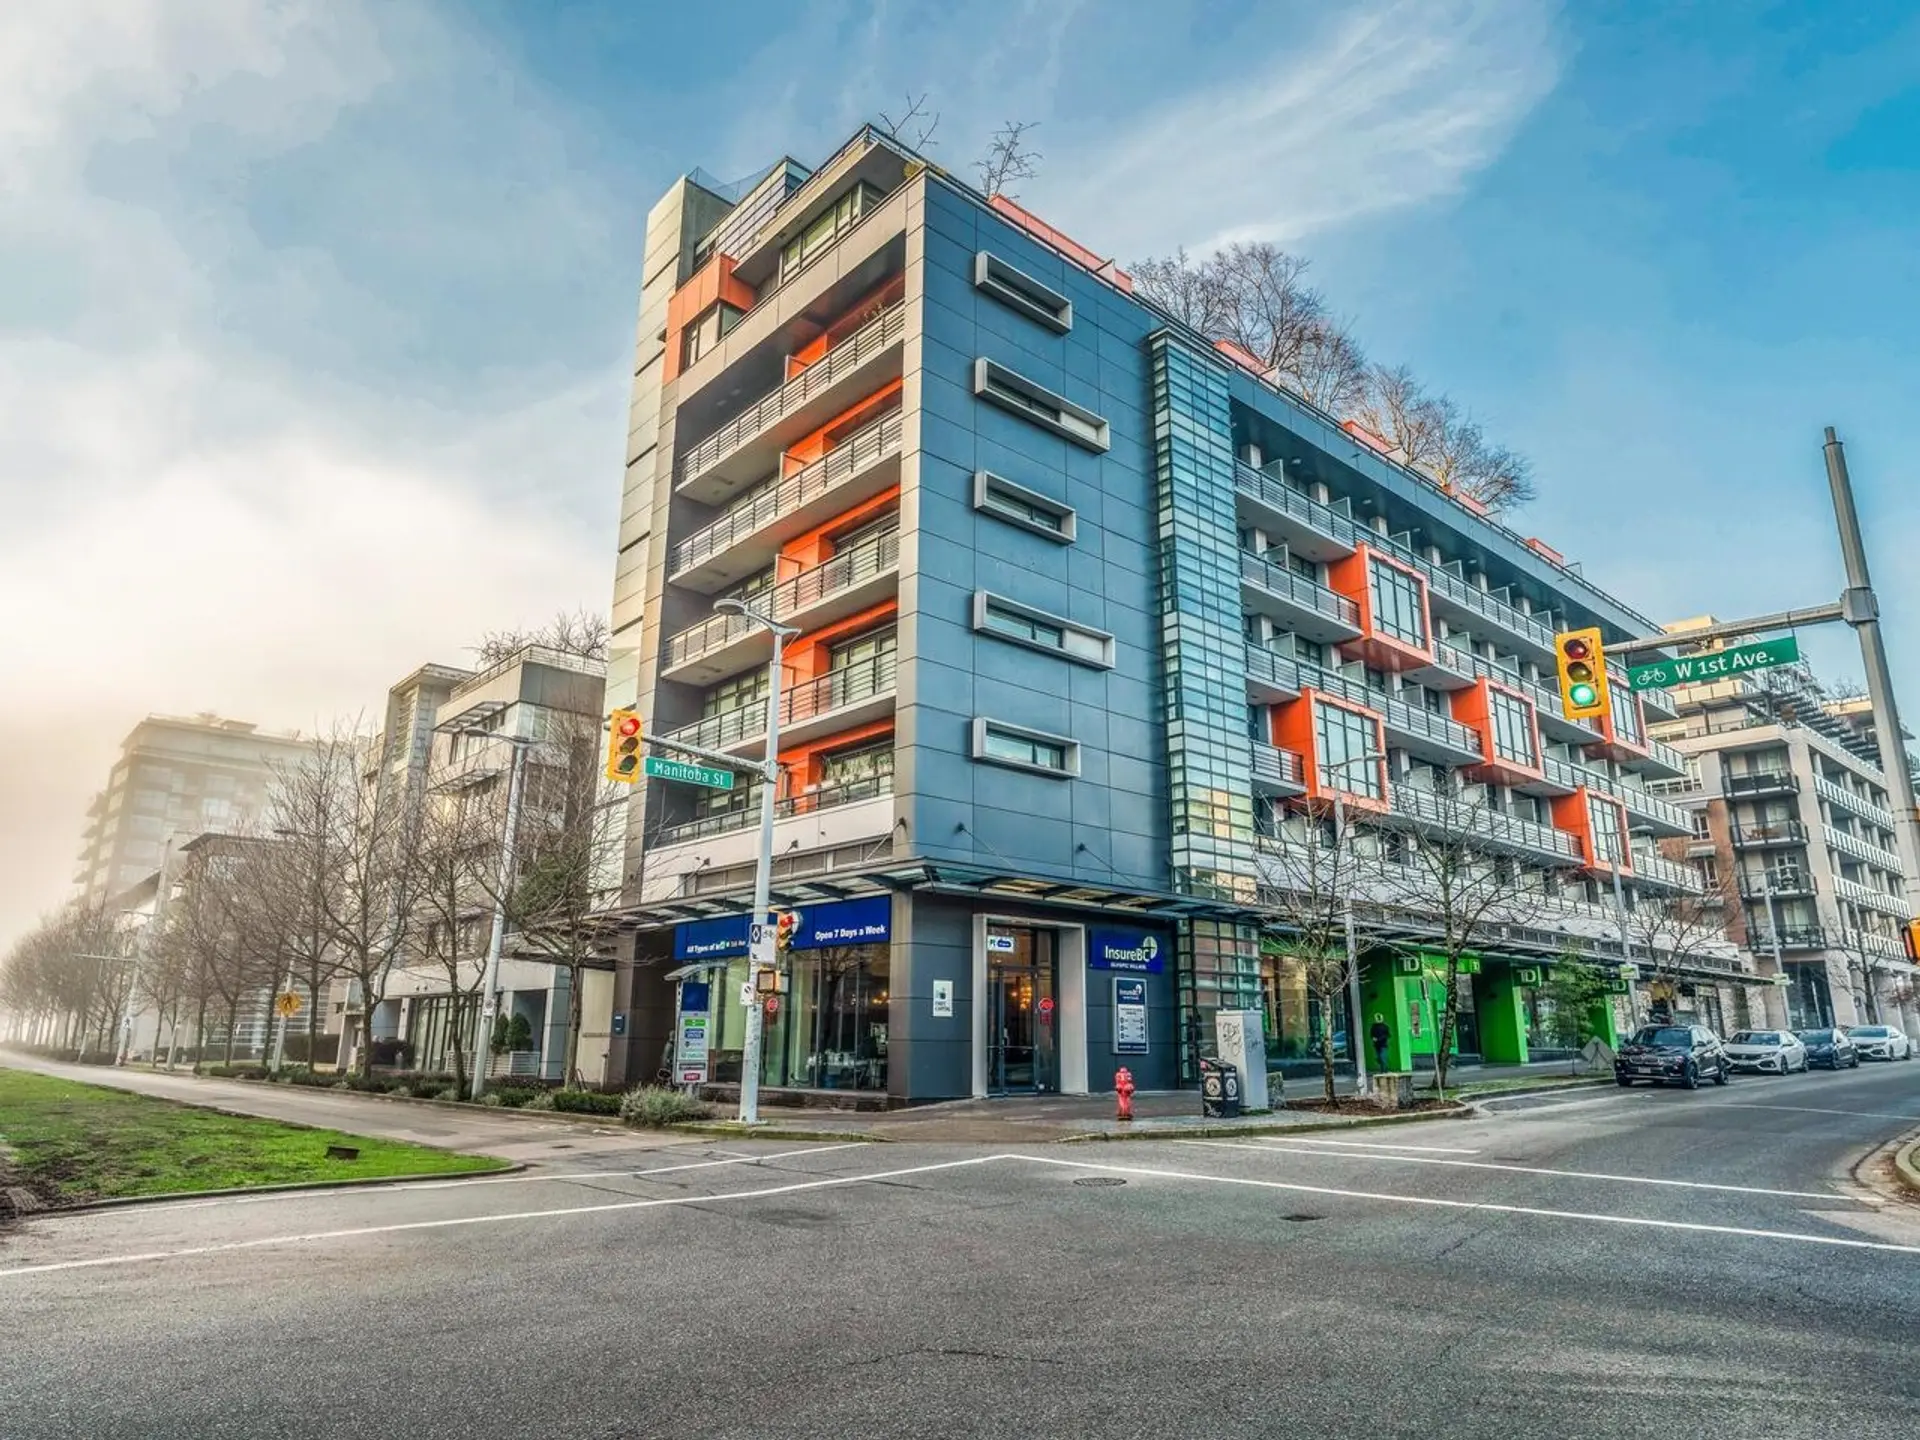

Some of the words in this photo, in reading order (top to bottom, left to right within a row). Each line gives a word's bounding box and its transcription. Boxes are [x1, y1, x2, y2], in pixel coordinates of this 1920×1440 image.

[1675, 661, 1692, 679] W
[1697, 656, 1728, 675] 1st
[1732, 650, 1775, 669] Ave.
[654, 761, 709, 783] Manitoba
[713, 773, 724, 786] St
[815, 931, 833, 942] Open
[834, 929, 840, 938] 7
[840, 928, 858, 939] Days
[865, 924, 886, 935] Week
[1105, 945, 1150, 962] InsureBC
[1399, 957, 1420, 972] TD
[1517, 969, 1536, 983] TD
